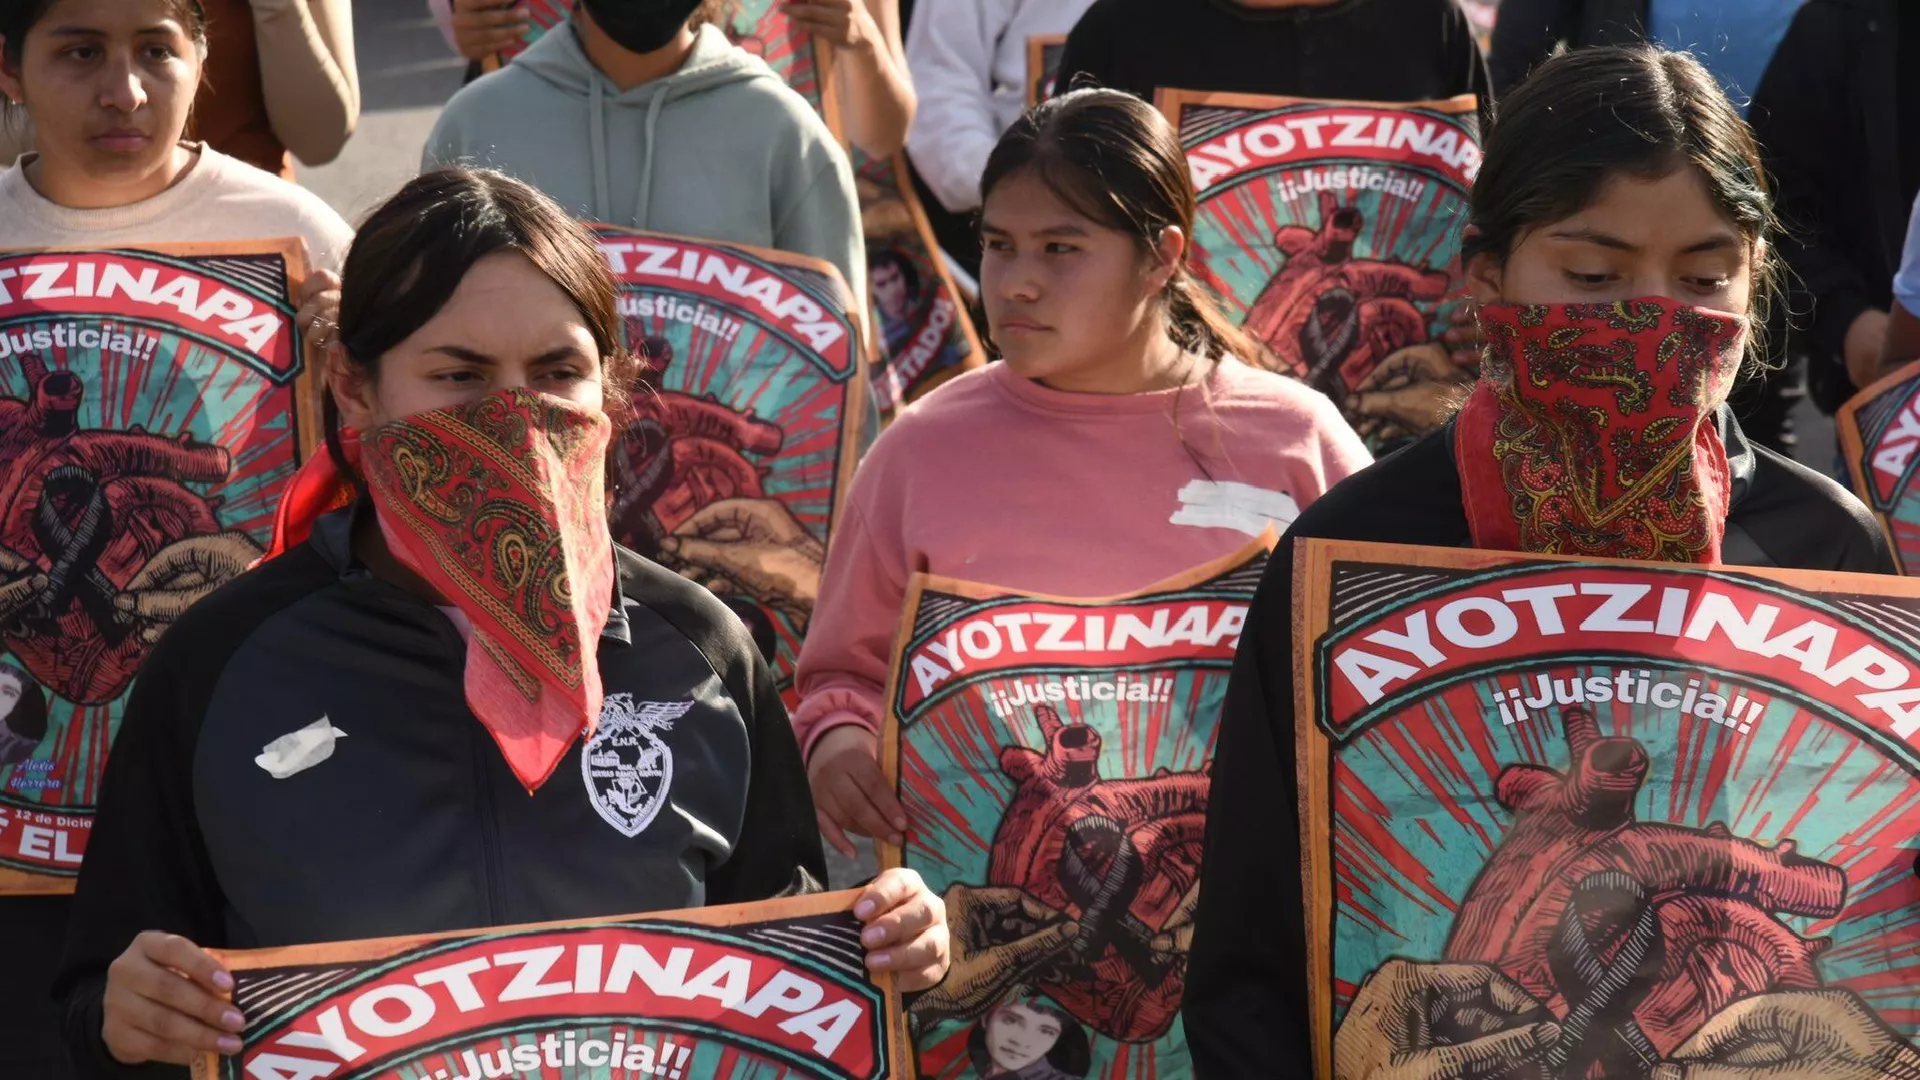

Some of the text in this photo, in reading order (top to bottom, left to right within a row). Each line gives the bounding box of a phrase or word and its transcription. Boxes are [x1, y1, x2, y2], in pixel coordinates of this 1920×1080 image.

[596, 243, 844, 353] TZINAPA
[616, 293, 741, 342] usticia!!
[1872, 391, 1920, 478] AY
[909, 604, 1250, 698] AYOTZINAP
[1333, 582, 1920, 740] AYOTZINAPA
[989, 676, 1174, 719] ¡¡Justicia!!
[1493, 668, 1764, 736] ¡¡Justicia!!
[15, 809, 33, 821] 12
[35, 814, 52, 824] de
[18, 823, 84, 864] EL
